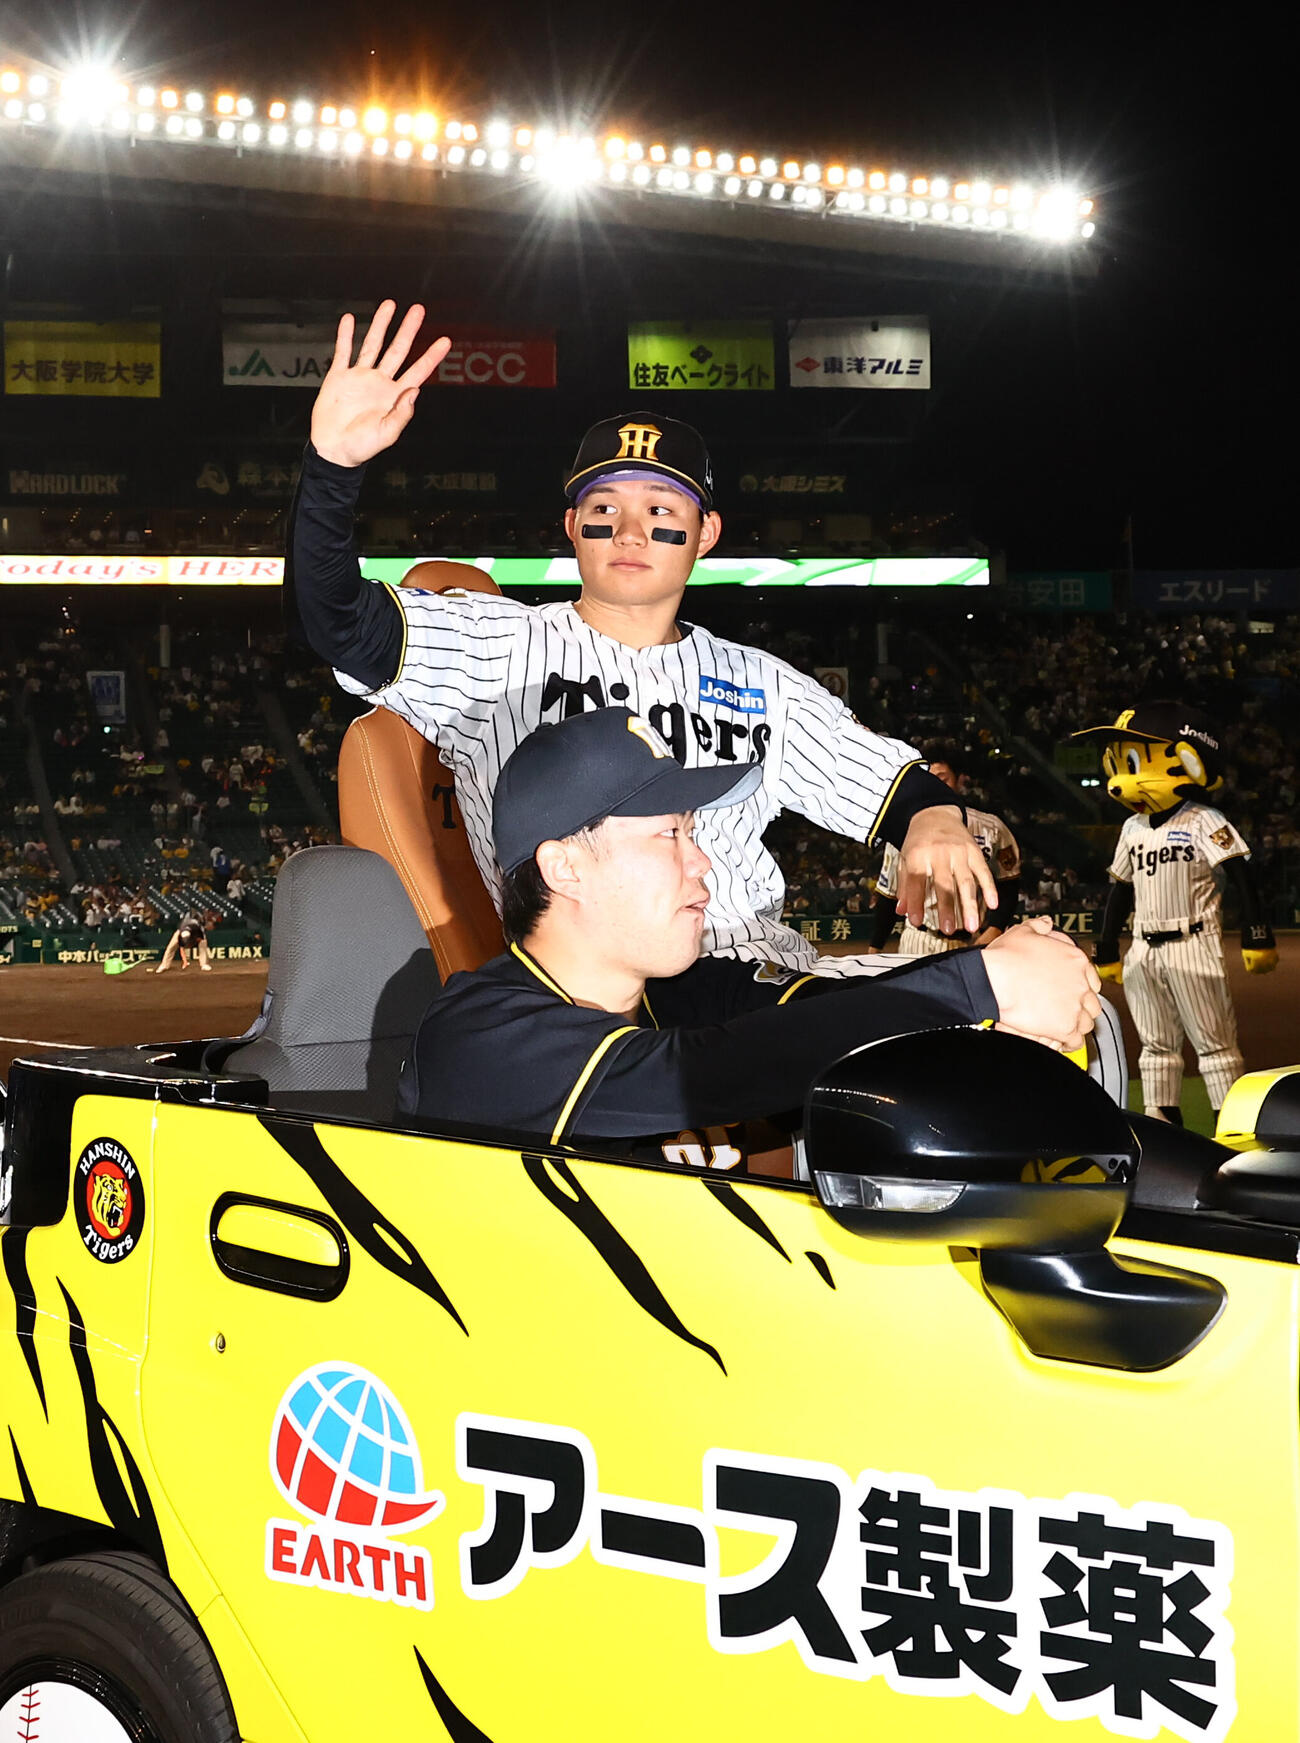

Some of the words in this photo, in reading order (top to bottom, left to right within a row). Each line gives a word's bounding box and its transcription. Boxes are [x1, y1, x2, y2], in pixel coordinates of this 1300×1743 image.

[11, 358, 155, 386] 大阪学院大学
[438, 351, 527, 383] ECC
[633, 362, 770, 388] 住友ベークライト
[823, 356, 923, 376] 東洋アルミ
[0, 560, 157, 580] oday's
[1159, 578, 1273, 603] エスリード
[700, 680, 766, 712] Joshin
[1179, 724, 1220, 751] Joshin
[1129, 840, 1195, 877] igers
[193, 947, 226, 960] LVE
[228, 946, 263, 959] MAX
[79, 1142, 136, 1180] HANSHIN
[83, 1224, 134, 1260] Tigers
[272, 1527, 427, 1602] EARTH
[465, 1426, 1219, 1731] アース製薬
